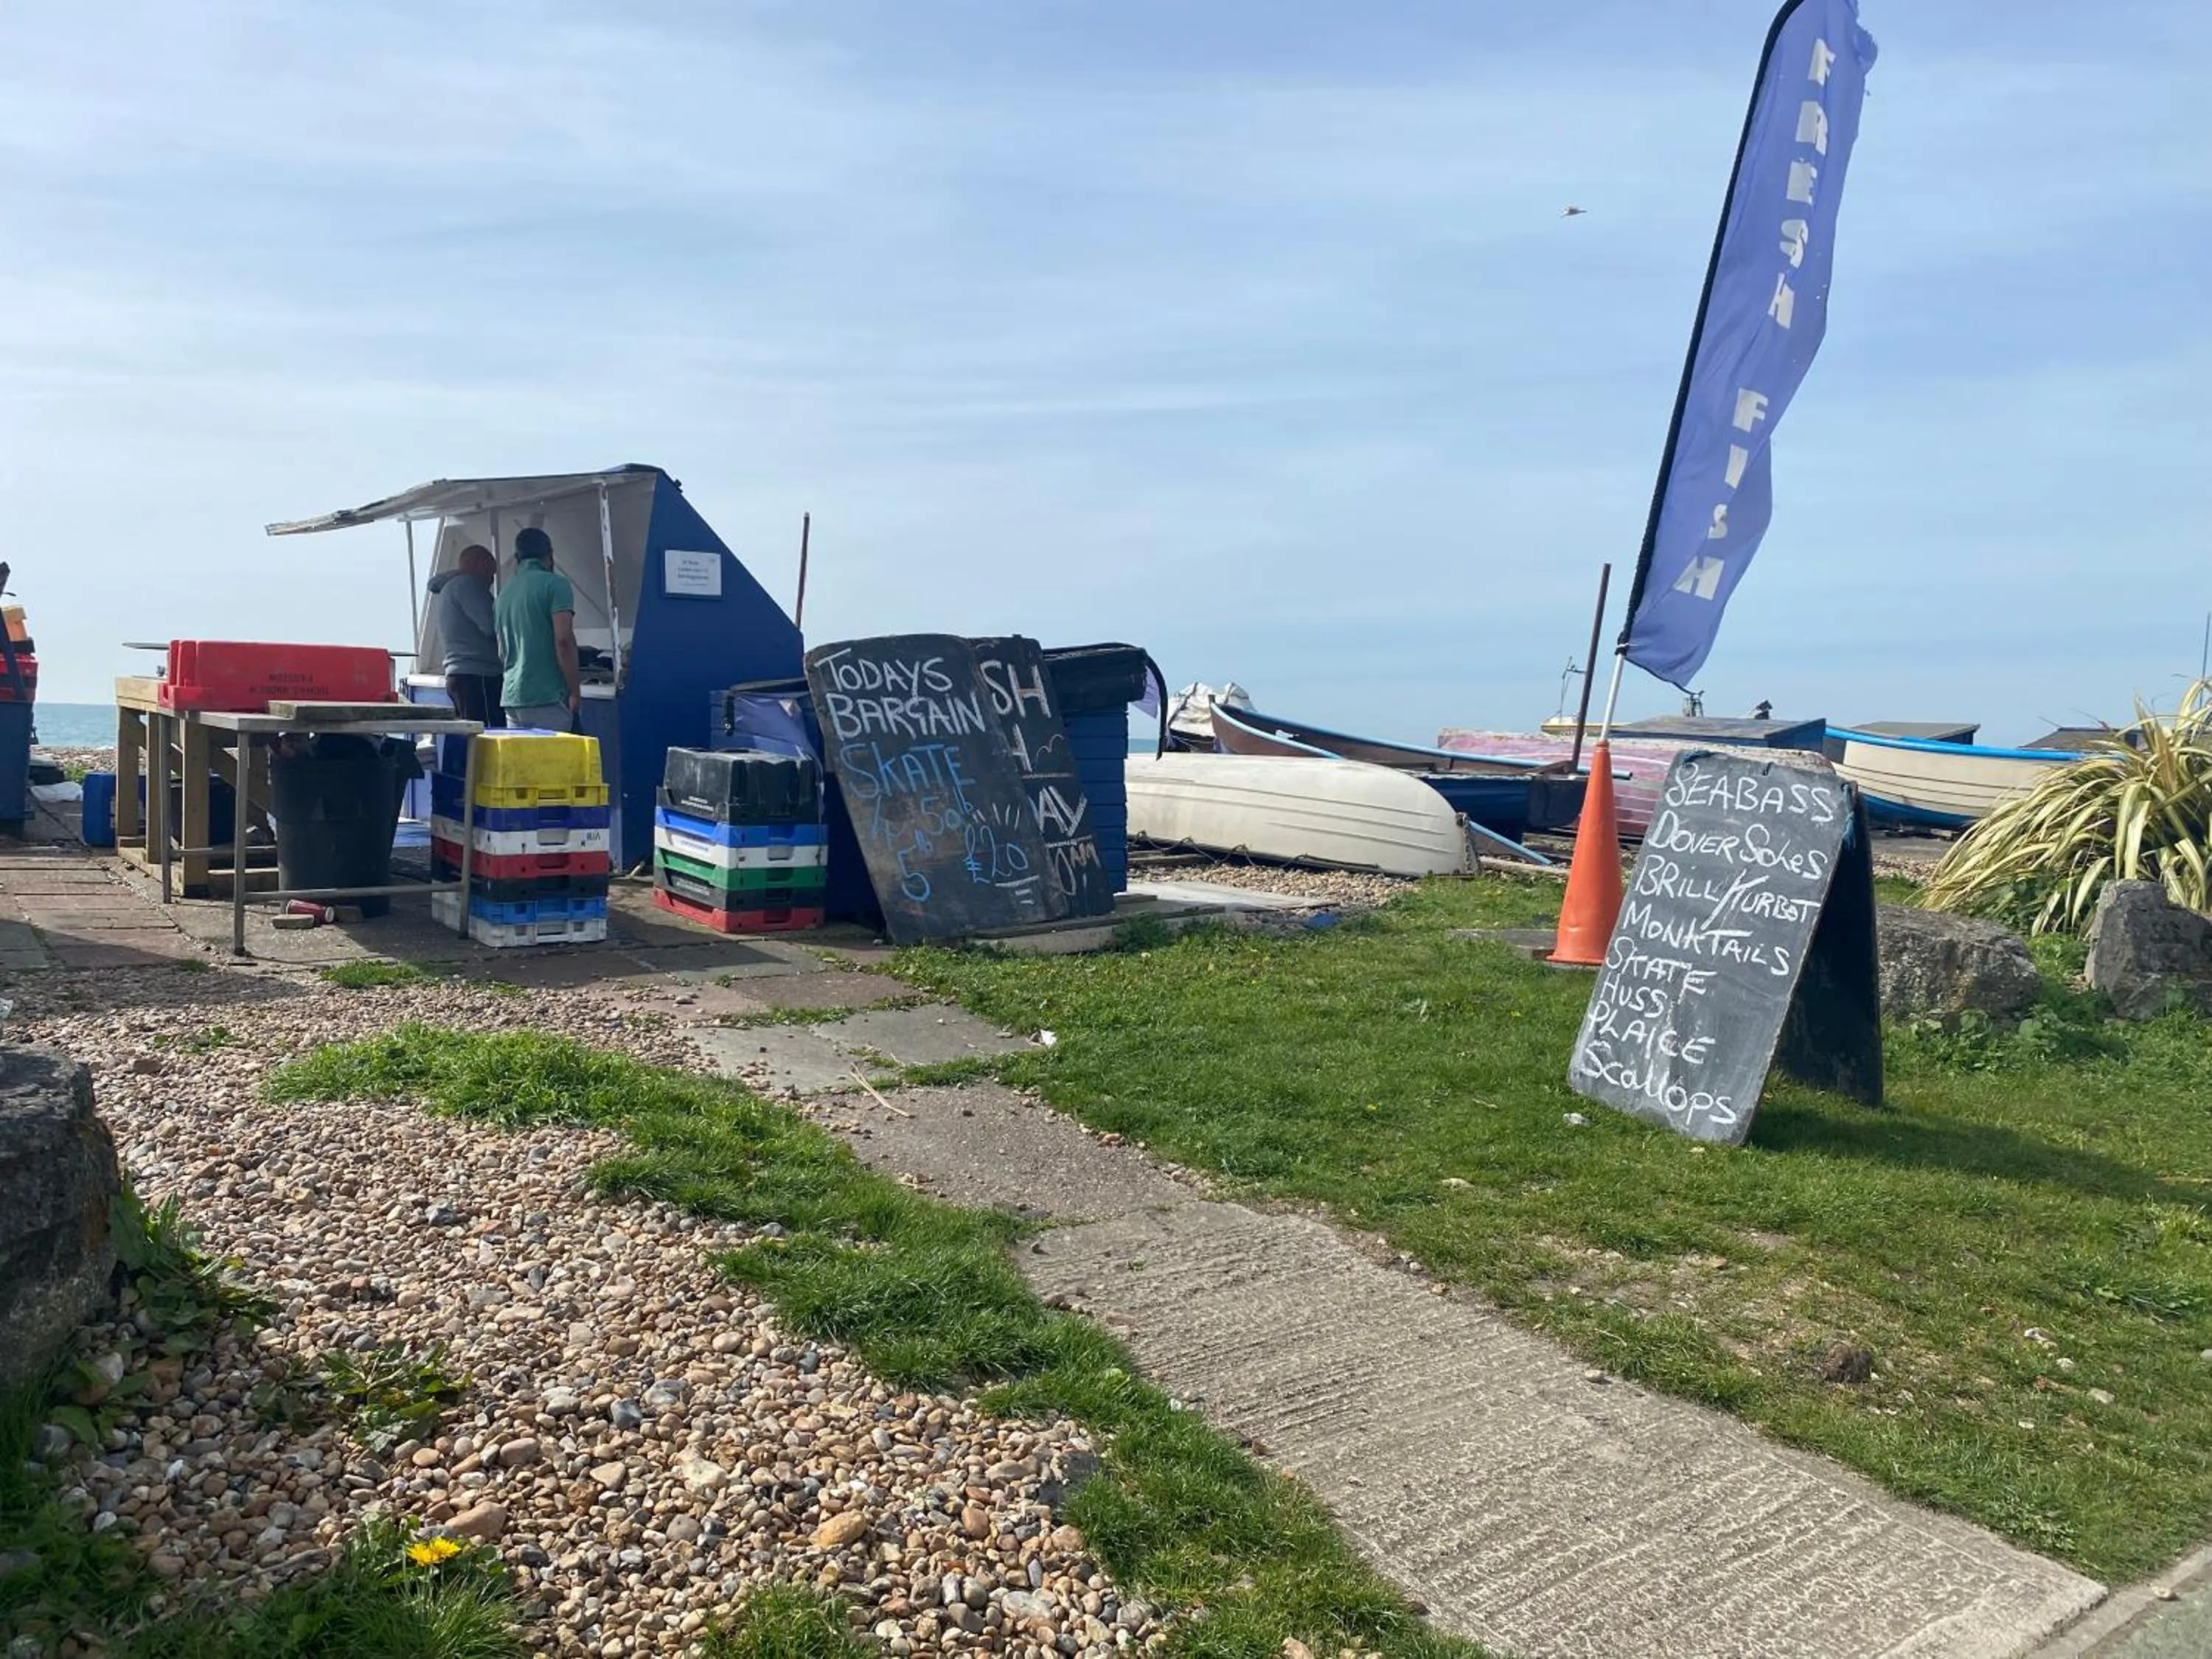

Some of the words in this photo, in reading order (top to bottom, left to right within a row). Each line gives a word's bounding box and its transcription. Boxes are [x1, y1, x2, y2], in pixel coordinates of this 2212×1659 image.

[1768, 38, 1836, 330] FRESH
[1672, 388, 1769, 601] FISH
[814, 647, 953, 706] TODAYS
[825, 691, 986, 740] BARGAIN
[839, 741, 977, 799] SKATE
[1664, 762, 1834, 822] SEABASS
[1648, 810, 1739, 864] DOVER
[1605, 936, 1718, 997] SKATE
[1599, 975, 1668, 1018] HUSS
[1587, 1000, 1717, 1065] PLAICE
